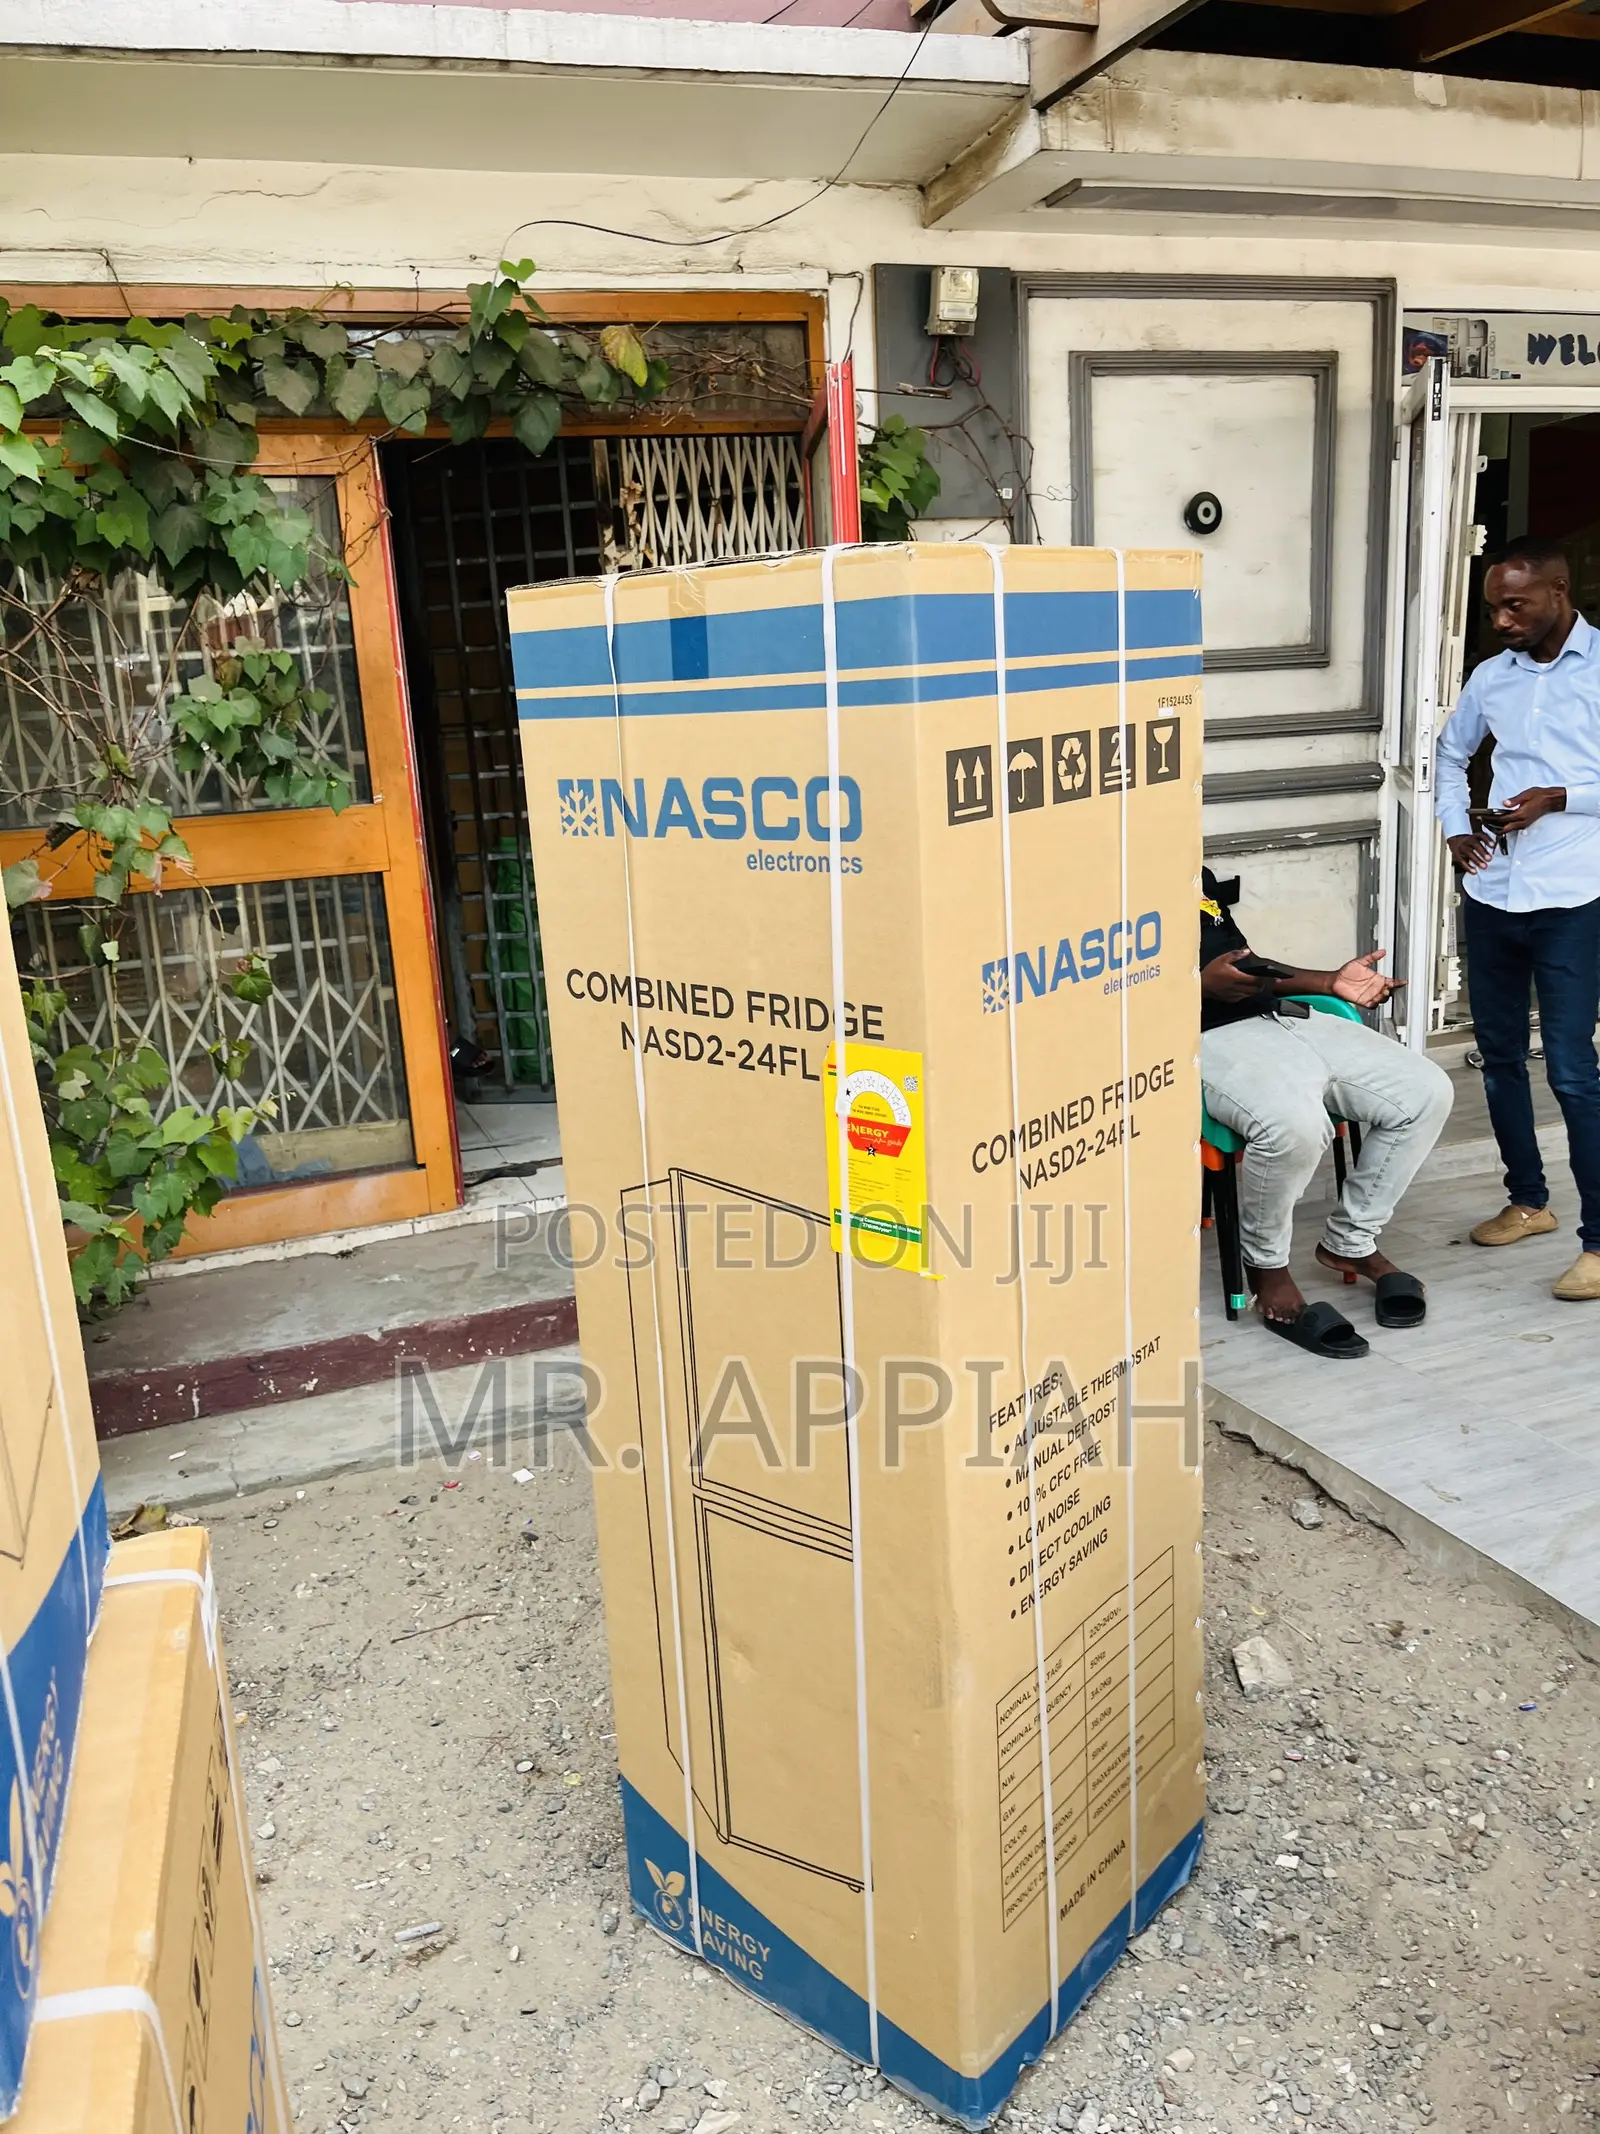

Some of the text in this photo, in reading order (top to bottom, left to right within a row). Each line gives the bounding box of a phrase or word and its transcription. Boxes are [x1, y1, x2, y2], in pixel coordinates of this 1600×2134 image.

[1527, 332, 1600, 366] WEL
[600, 776, 863, 842] NASCO
[746, 849, 863, 874] electroncs
[1013, 910, 1161, 1005] NASCO
[566, 969, 884, 1041] COMBINED FRIDGE
[620, 1021, 820, 1082] NASD2-24FL
[972, 1058, 1174, 1173] COMBINED FRIDGE
[1067, 1398, 1117, 1447] DEFROST
[1017, 1440, 1102, 1516] 10% CFC FREE
[1048, 1488, 1081, 1528] NOISE
[1063, 1495, 1111, 1546] COOLING
[1020, 1528, 1108, 1615] ENERGY SAVING
[1000, 1690, 1032, 1725] NOMINAL
[1001, 1723, 1032, 1757] NOMINAL
[1004, 1850, 1034, 1886] CARTON
[1060, 1839, 1127, 1921] MADE IN CHINA
